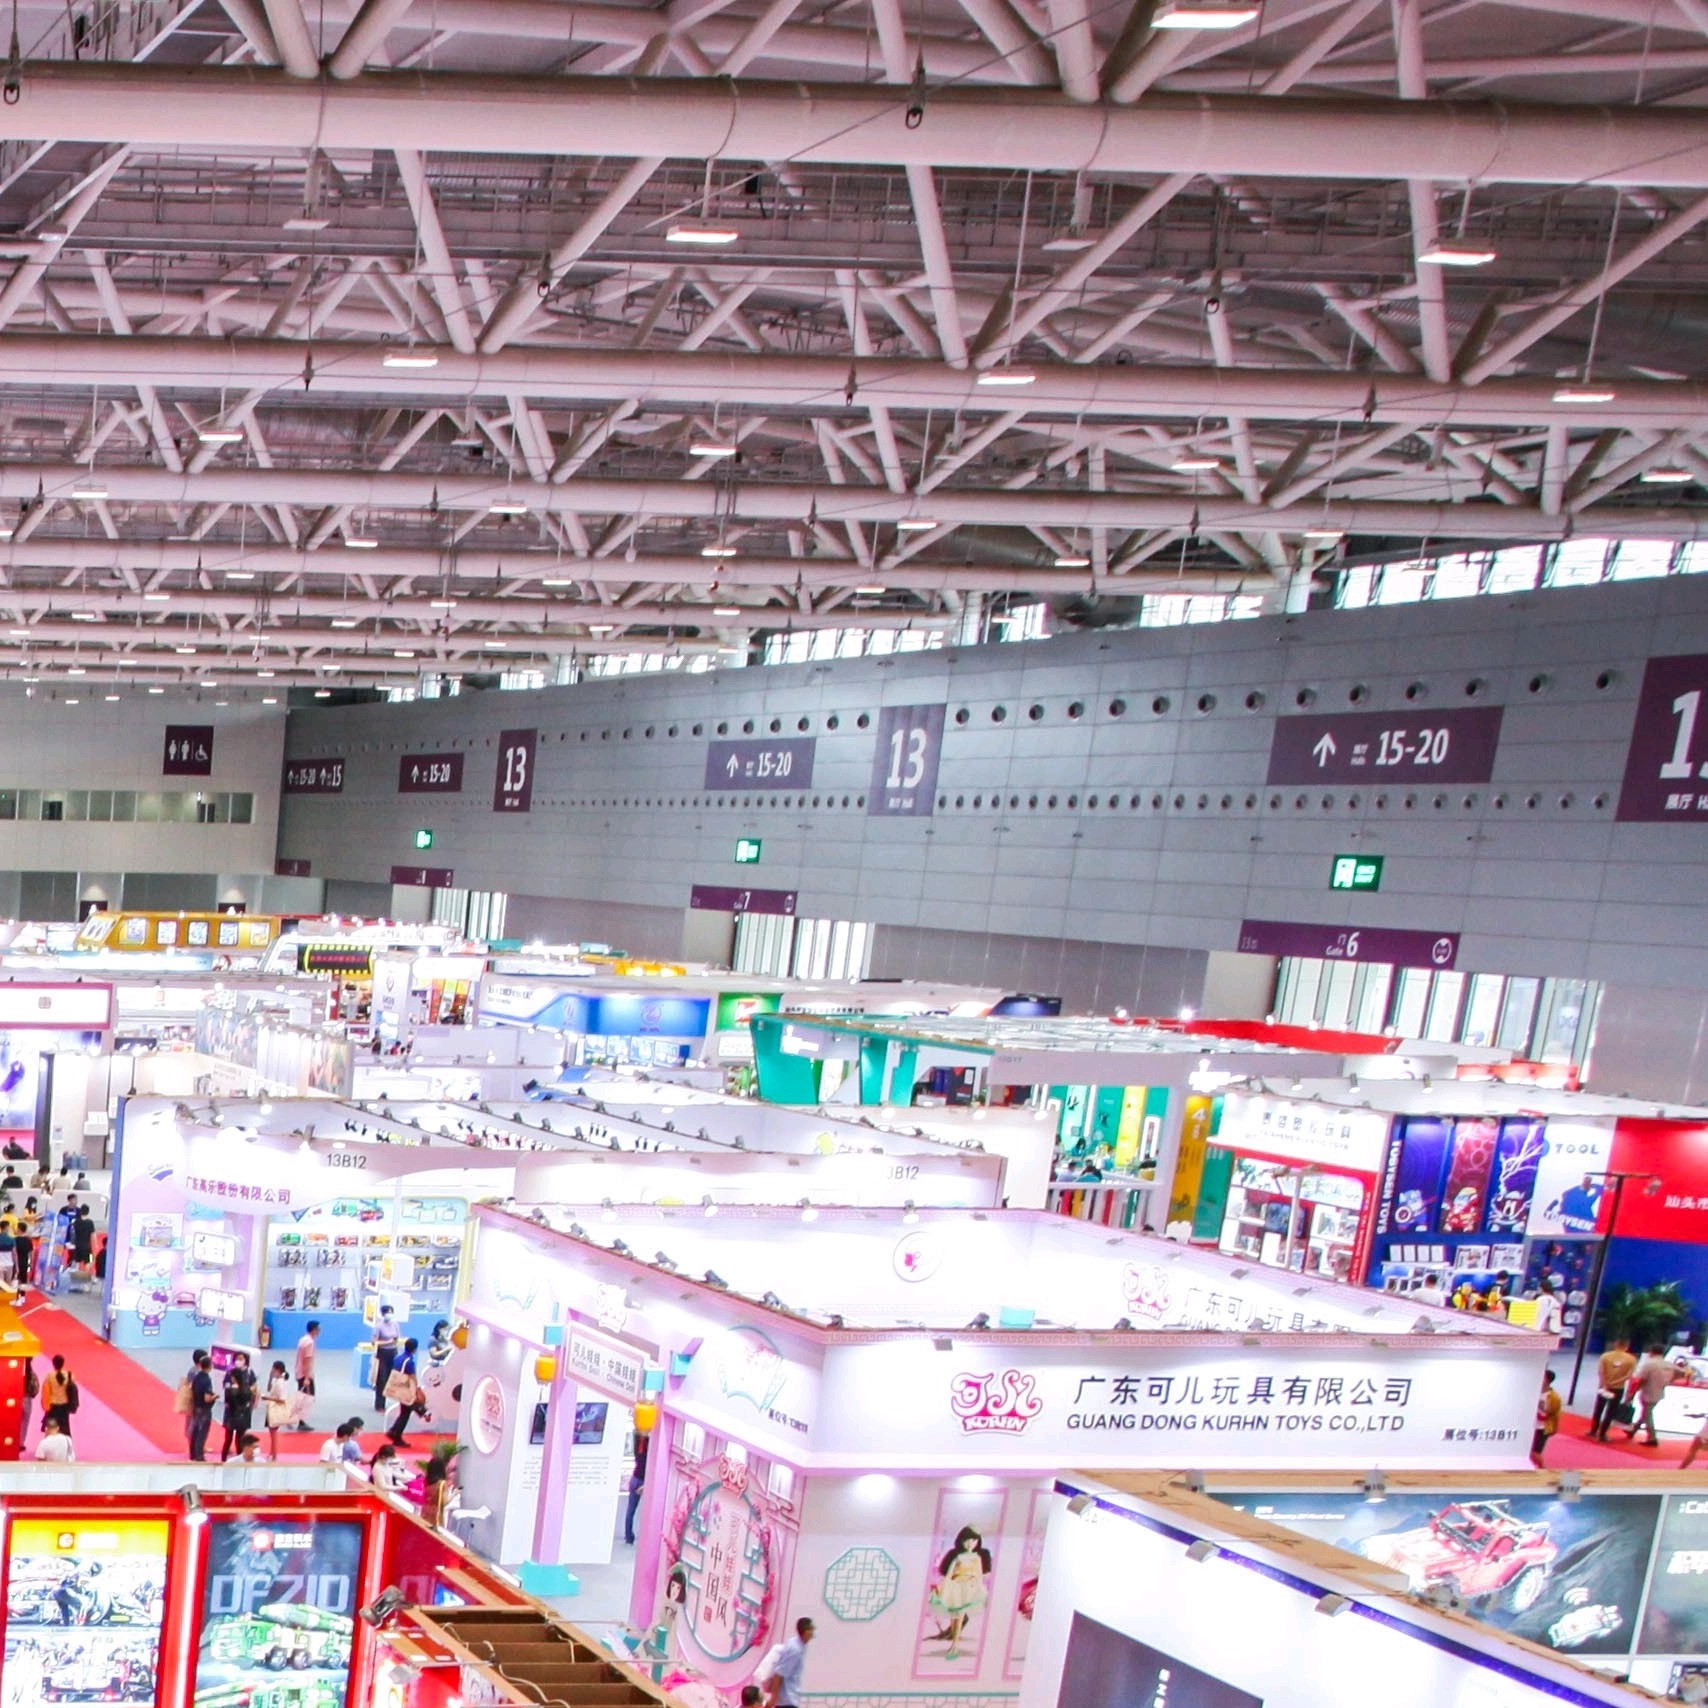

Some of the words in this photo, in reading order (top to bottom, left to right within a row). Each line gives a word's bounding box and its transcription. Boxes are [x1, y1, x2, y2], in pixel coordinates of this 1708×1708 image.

[1375, 729, 1449, 766] 15-20
[1659, 690, 1708, 780] 1
[503, 746, 527, 792] 13
[757, 752, 792, 777] 15-20
[886, 728, 927, 789] 13
[429, 763, 452, 784] 15-20
[1347, 932, 1359, 958] 6
[326, 1153, 368, 1170] 13B12
[1073, 1375, 1413, 1407] 广东可儿玩具有限公司
[1066, 1413, 1137, 1431] GUANG
[1140, 1413, 1197, 1431] DONG
[1201, 1414, 1269, 1432] KURHN
[1275, 1415, 1323, 1433] TOYS
[1328, 1415, 1405, 1434] CO.,LTD
